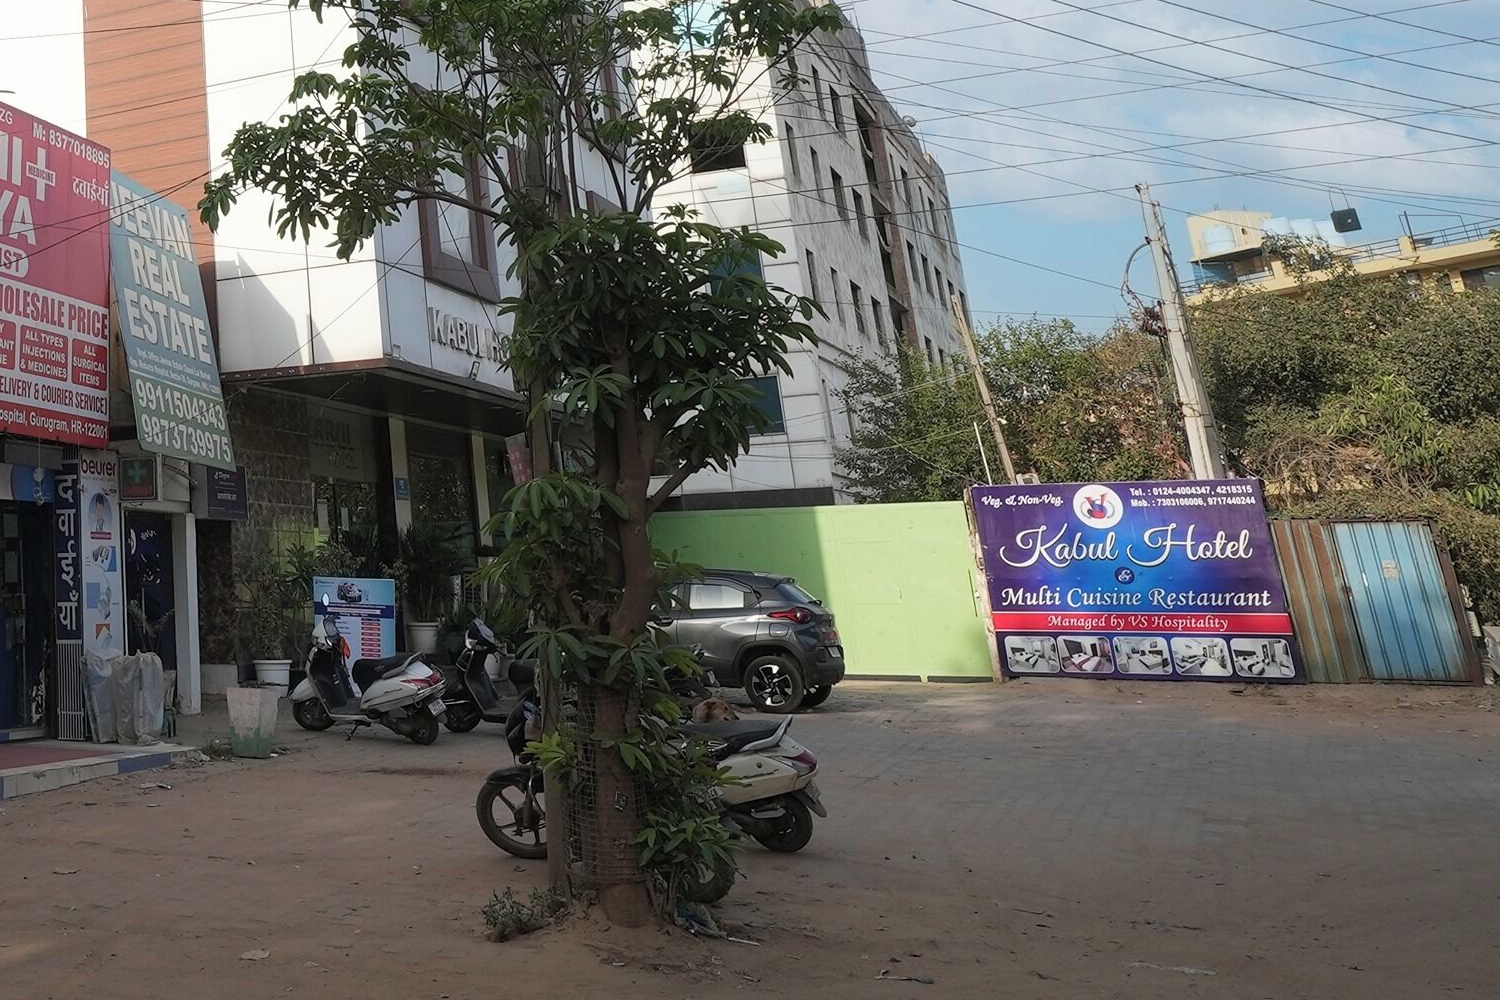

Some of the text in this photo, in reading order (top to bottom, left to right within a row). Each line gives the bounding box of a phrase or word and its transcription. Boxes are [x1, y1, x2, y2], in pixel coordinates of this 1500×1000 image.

[33, 122, 110, 168] M: 8377018895
[27, 163, 56, 184] MEDICINE
[110, 178, 194, 264] JEEVAN
[127, 236, 191, 308] REAL
[68, 306, 109, 341] PRICE
[123, 287, 212, 366] ESTATE
[428, 306, 485, 359] KABUL
[22, 343, 66, 363] INJECTIONS
[72, 356, 106, 374] SURGICAL
[135, 378, 226, 432] 9911504343
[141, 413, 232, 464] 9873739975
[80, 453, 117, 477] beurer
[981, 493, 1064, 509] Veg. Non-Veg.
[1129, 488, 1146, 496] Tel.
[1131, 499, 1151, 507] Mob.
[1000, 522, 1253, 568] Kabul Hotel
[1116, 570, 1131, 582] &
[1001, 585, 1271, 609] Multi Cuisine Restaurant
[1048, 614, 1229, 631] Managed by VS Hospitality
